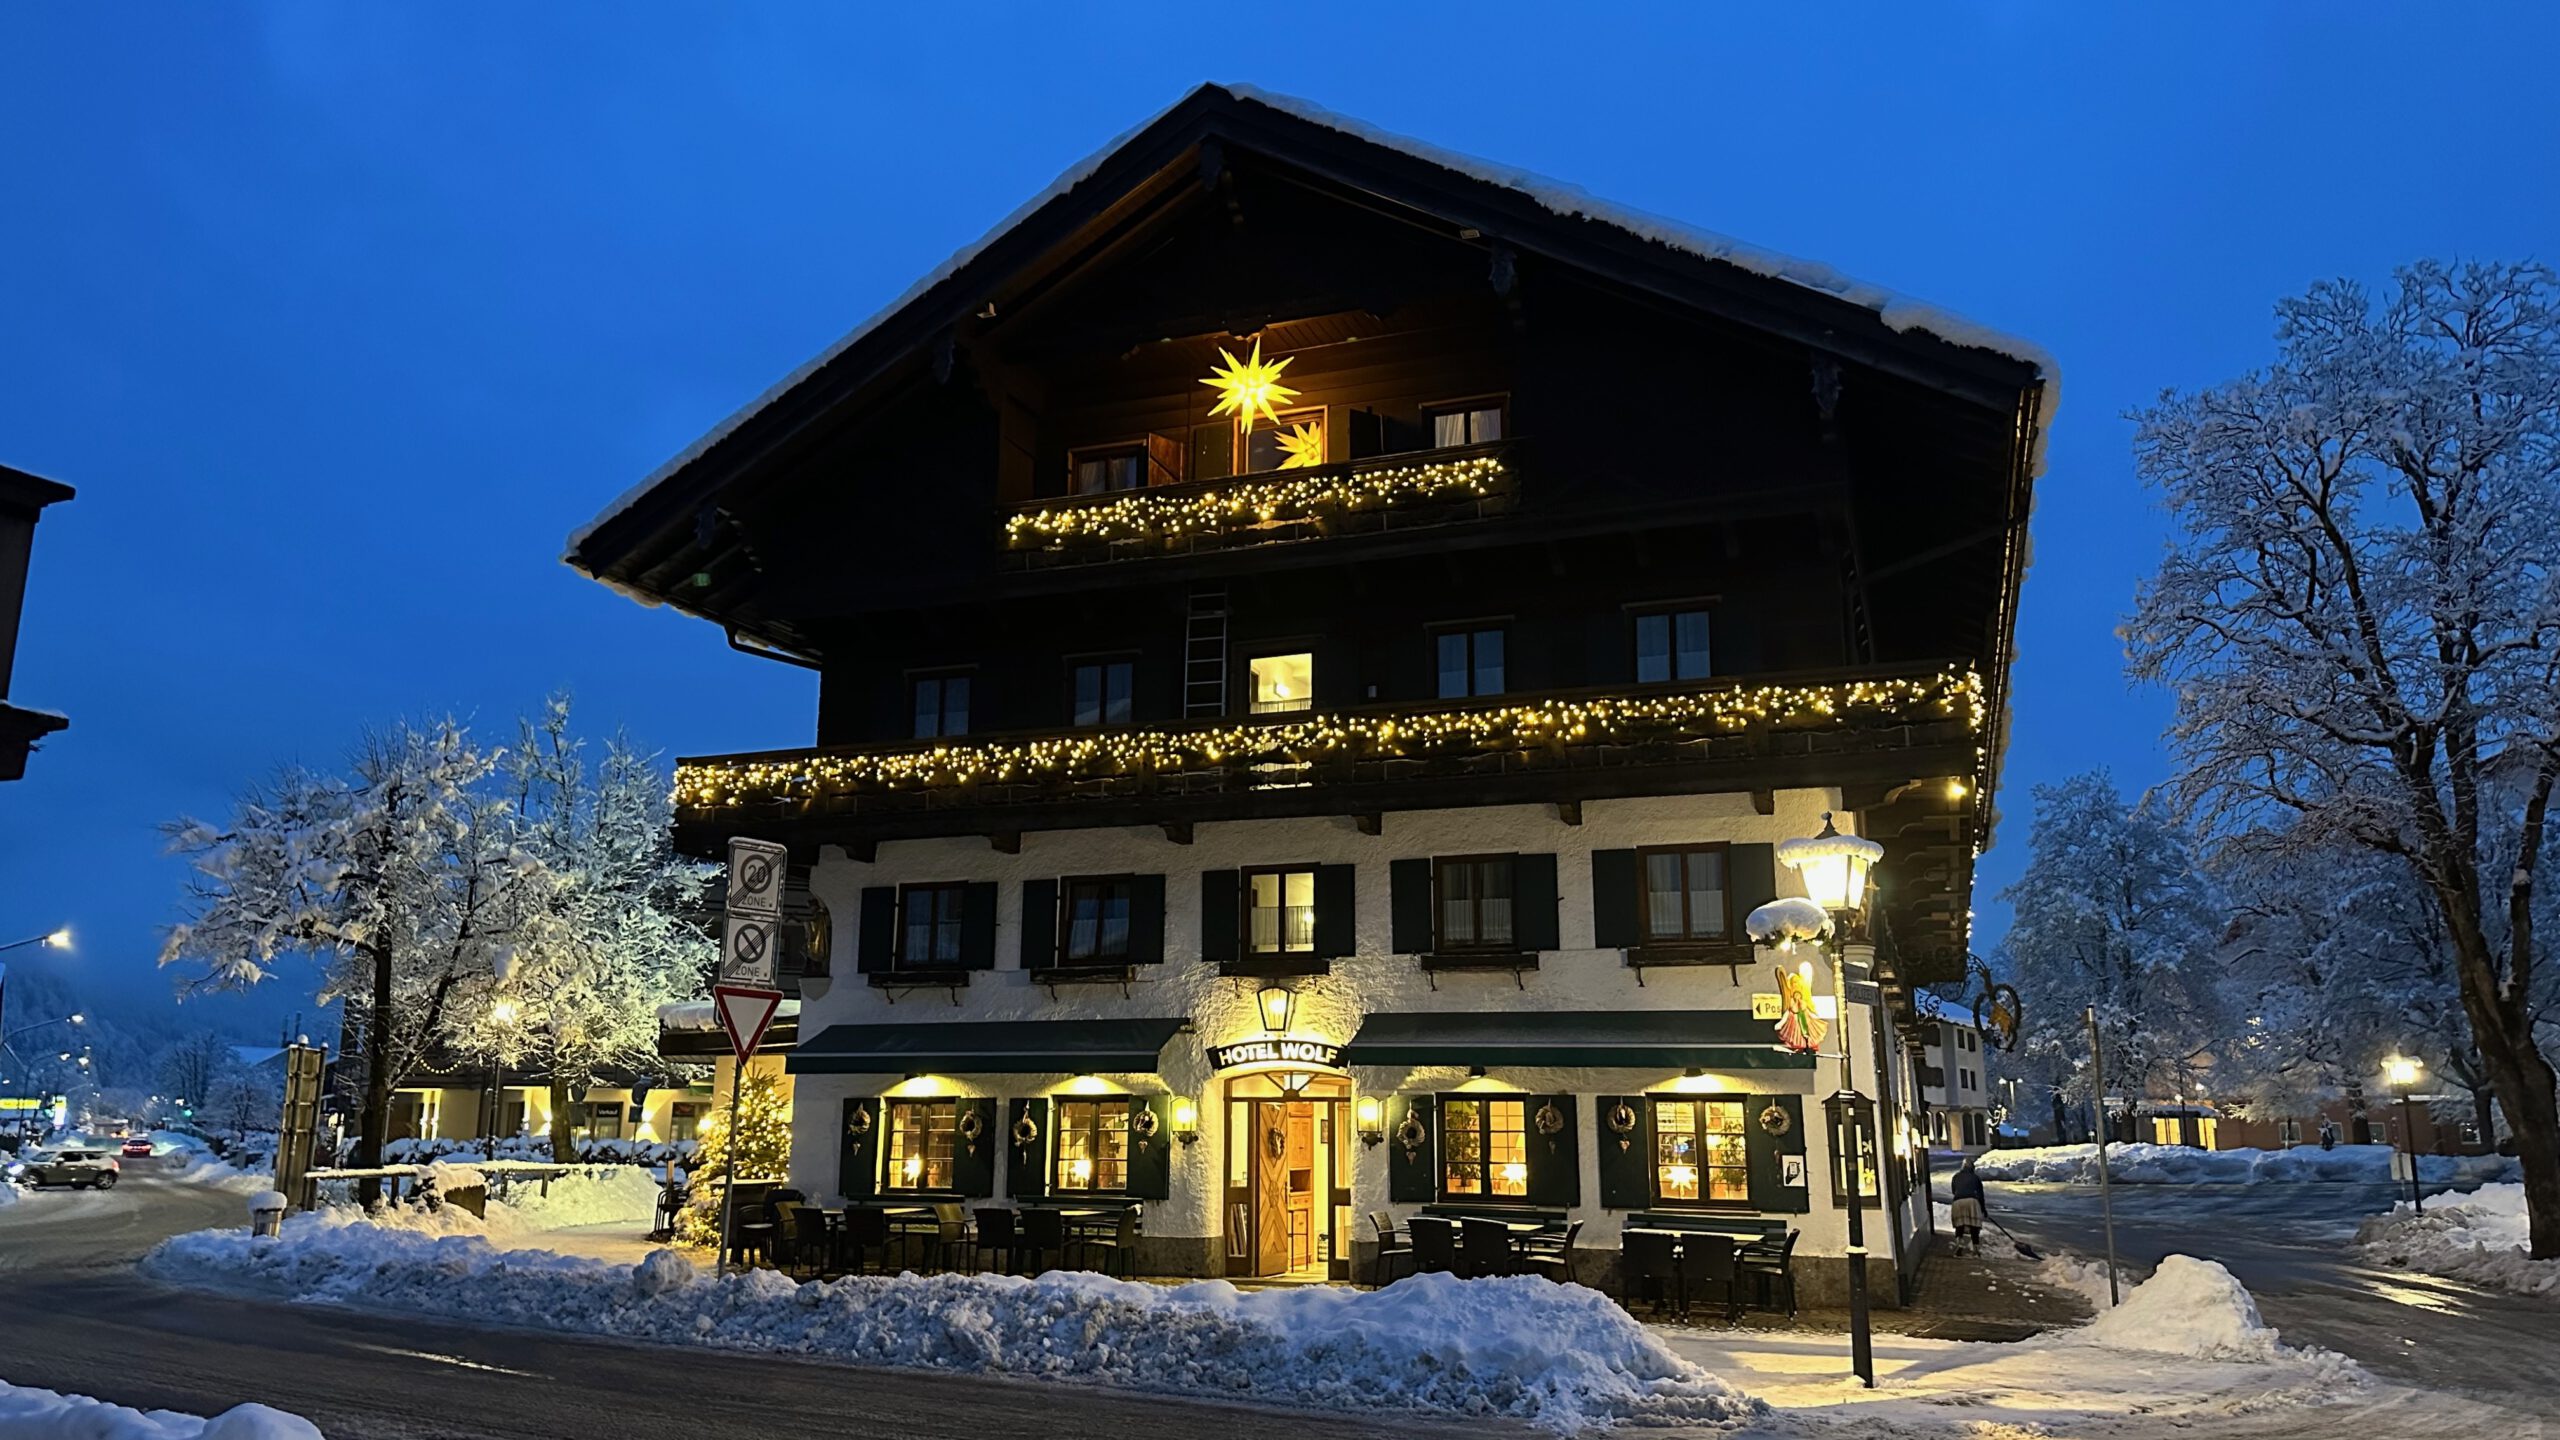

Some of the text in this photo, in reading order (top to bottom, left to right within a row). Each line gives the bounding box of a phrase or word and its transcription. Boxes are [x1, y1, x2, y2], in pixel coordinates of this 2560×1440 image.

[748, 864, 766, 883] 20
[741, 895, 767, 908] ZONE
[735, 965, 760, 978] ZONE
[1765, 1003, 1782, 1013] Pos
[1218, 1042, 1338, 1066] HOTEL WOLF
